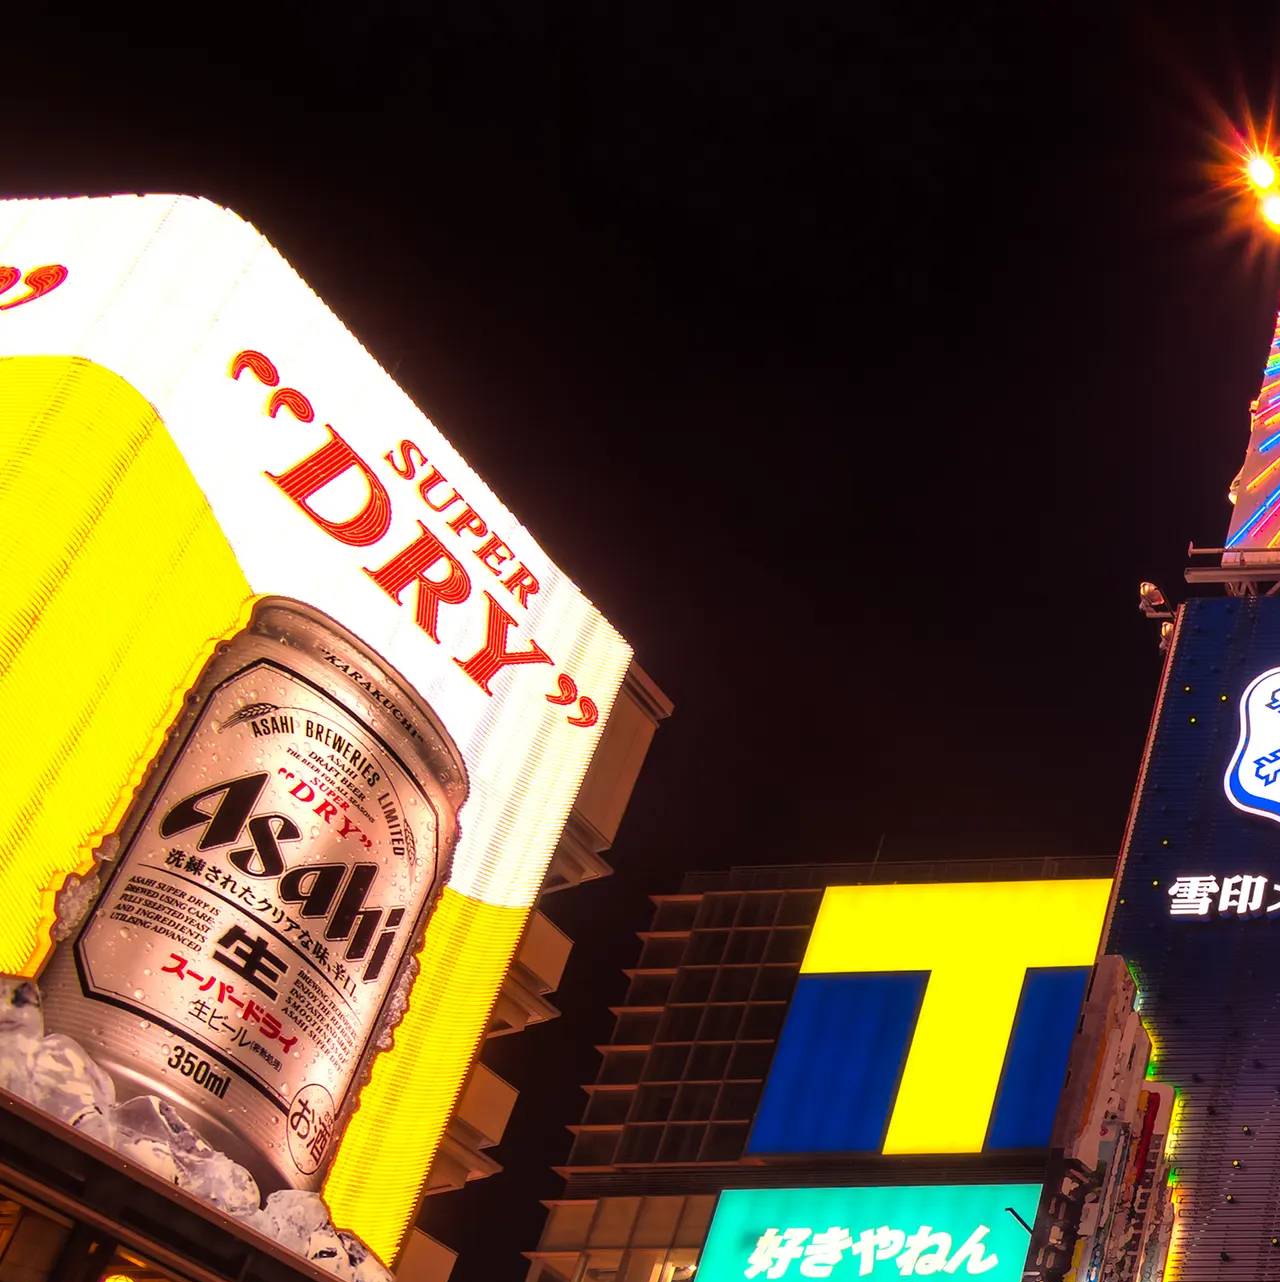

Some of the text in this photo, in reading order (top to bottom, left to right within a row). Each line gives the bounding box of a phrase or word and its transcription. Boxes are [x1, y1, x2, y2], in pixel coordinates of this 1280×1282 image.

[383, 440, 543, 608] SUPER
[251, 716, 405, 856] ASAHI BREWERIES LIMITED
[308, 751, 367, 802] DRAFT BEER
[310, 776, 350, 812] SUPER
[327, 753, 359, 780] ASAHI
[157, 881, 188, 899] SUPER
[188, 893, 210, 909] DRY
[159, 770, 406, 984] Asahi
[136, 908, 208, 943] INGREDIENTS
[185, 915, 212, 933] YEAST
[212, 923, 290, 1001] 生
[161, 952, 299, 1053] スーパードライ
[167, 1045, 231, 1100] 350ml
[744, 1224, 998, 1280] 好きやねん
